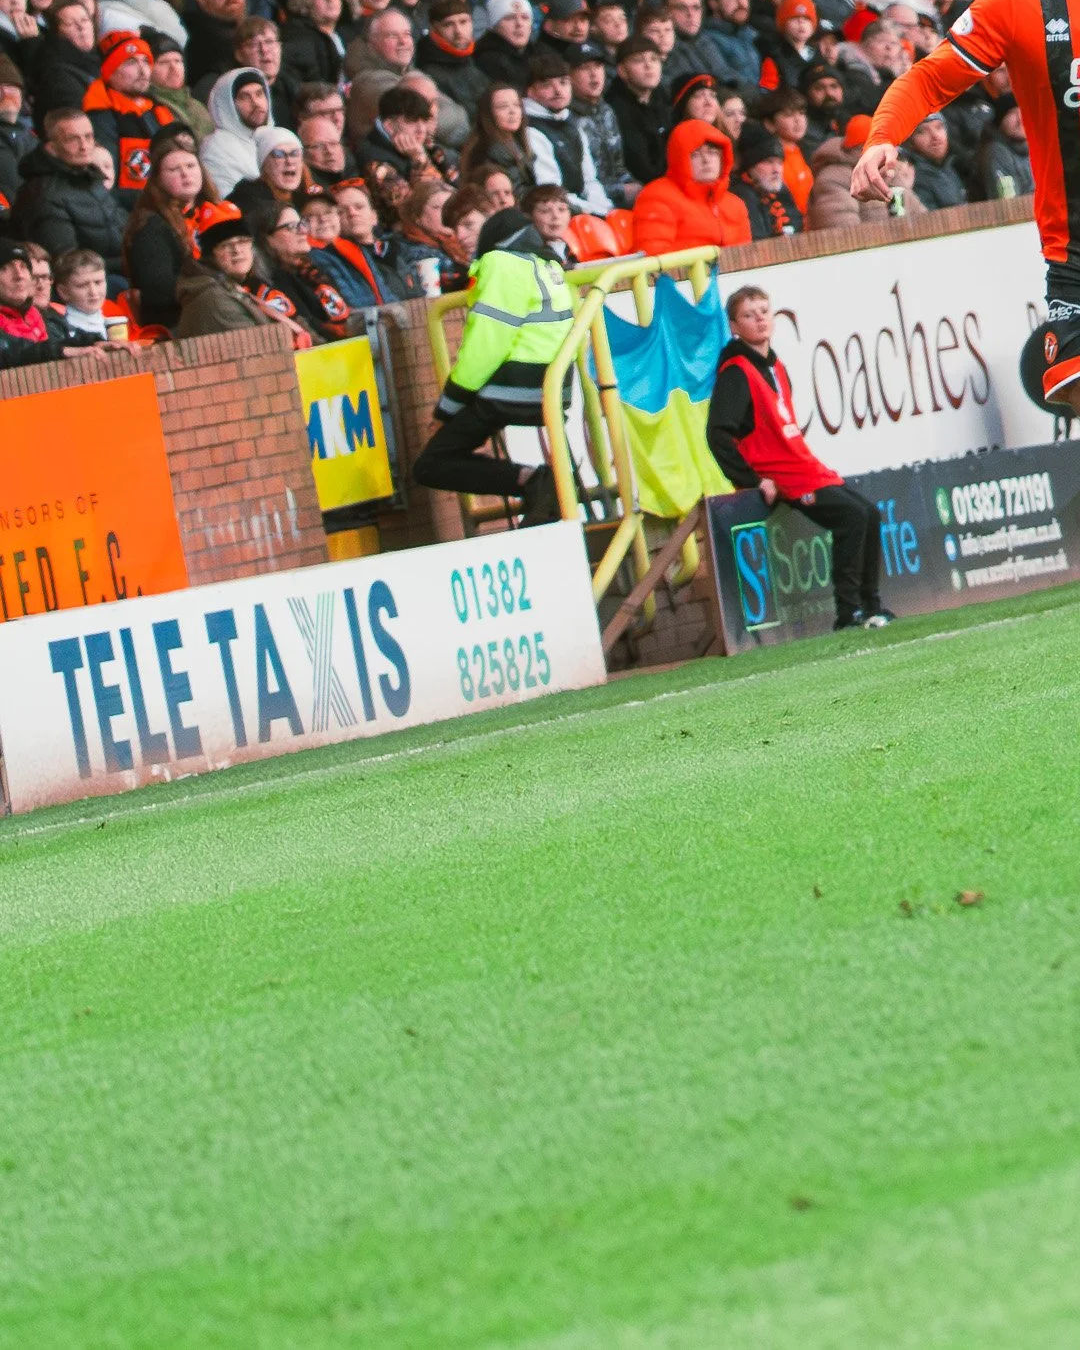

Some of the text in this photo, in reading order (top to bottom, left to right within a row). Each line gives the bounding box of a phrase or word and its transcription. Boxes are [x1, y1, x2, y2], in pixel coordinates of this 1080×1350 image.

[76, 493, 99, 515] OF
[952, 480, 1005, 526] 01382
[450, 557, 532, 625] 01382
[48, 579, 412, 779] TELE TAXIS
[457, 631, 552, 703] 825825
